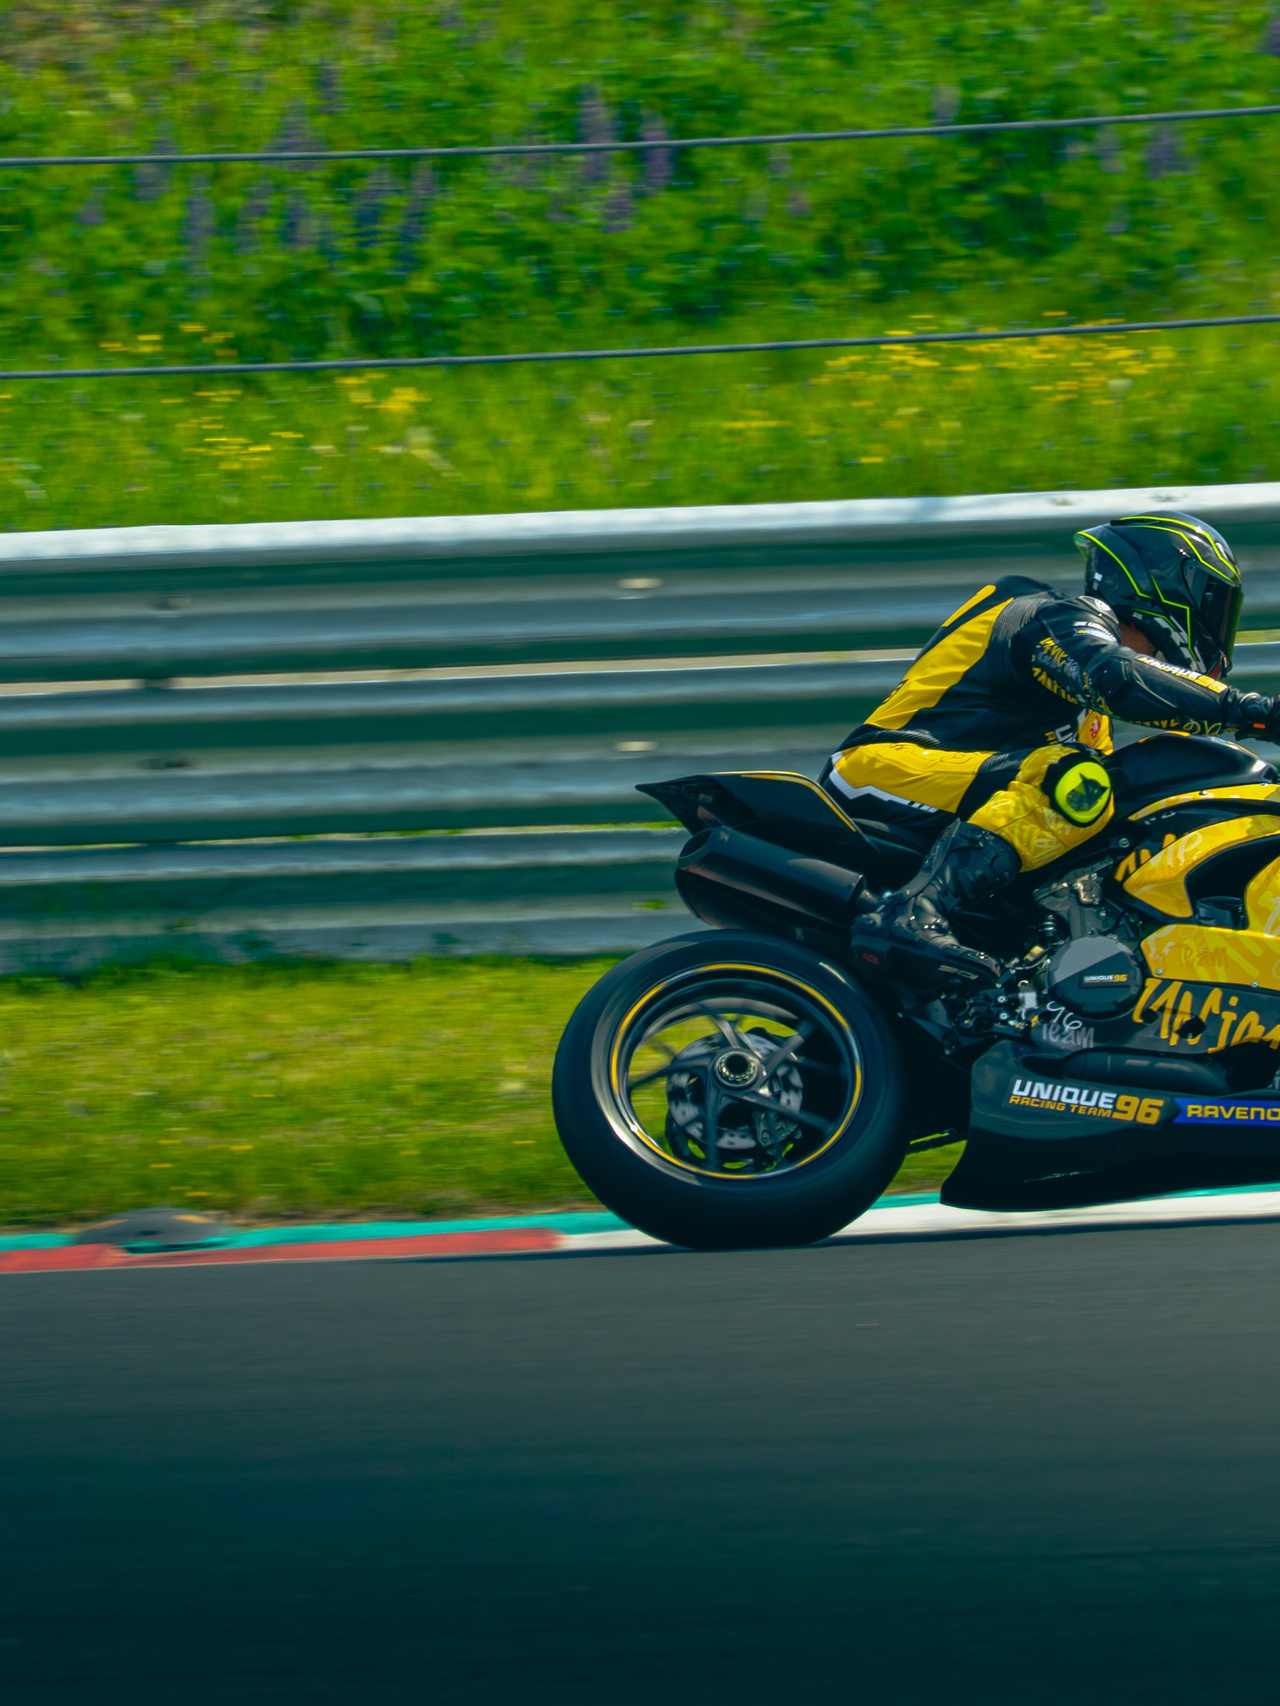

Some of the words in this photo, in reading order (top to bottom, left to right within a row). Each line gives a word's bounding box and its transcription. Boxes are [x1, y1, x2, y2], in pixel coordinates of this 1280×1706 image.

[1046, 1000, 1083, 1032] 96
[1008, 1094, 1067, 1112] RACING
[1070, 1104, 1113, 1118] TEAM
